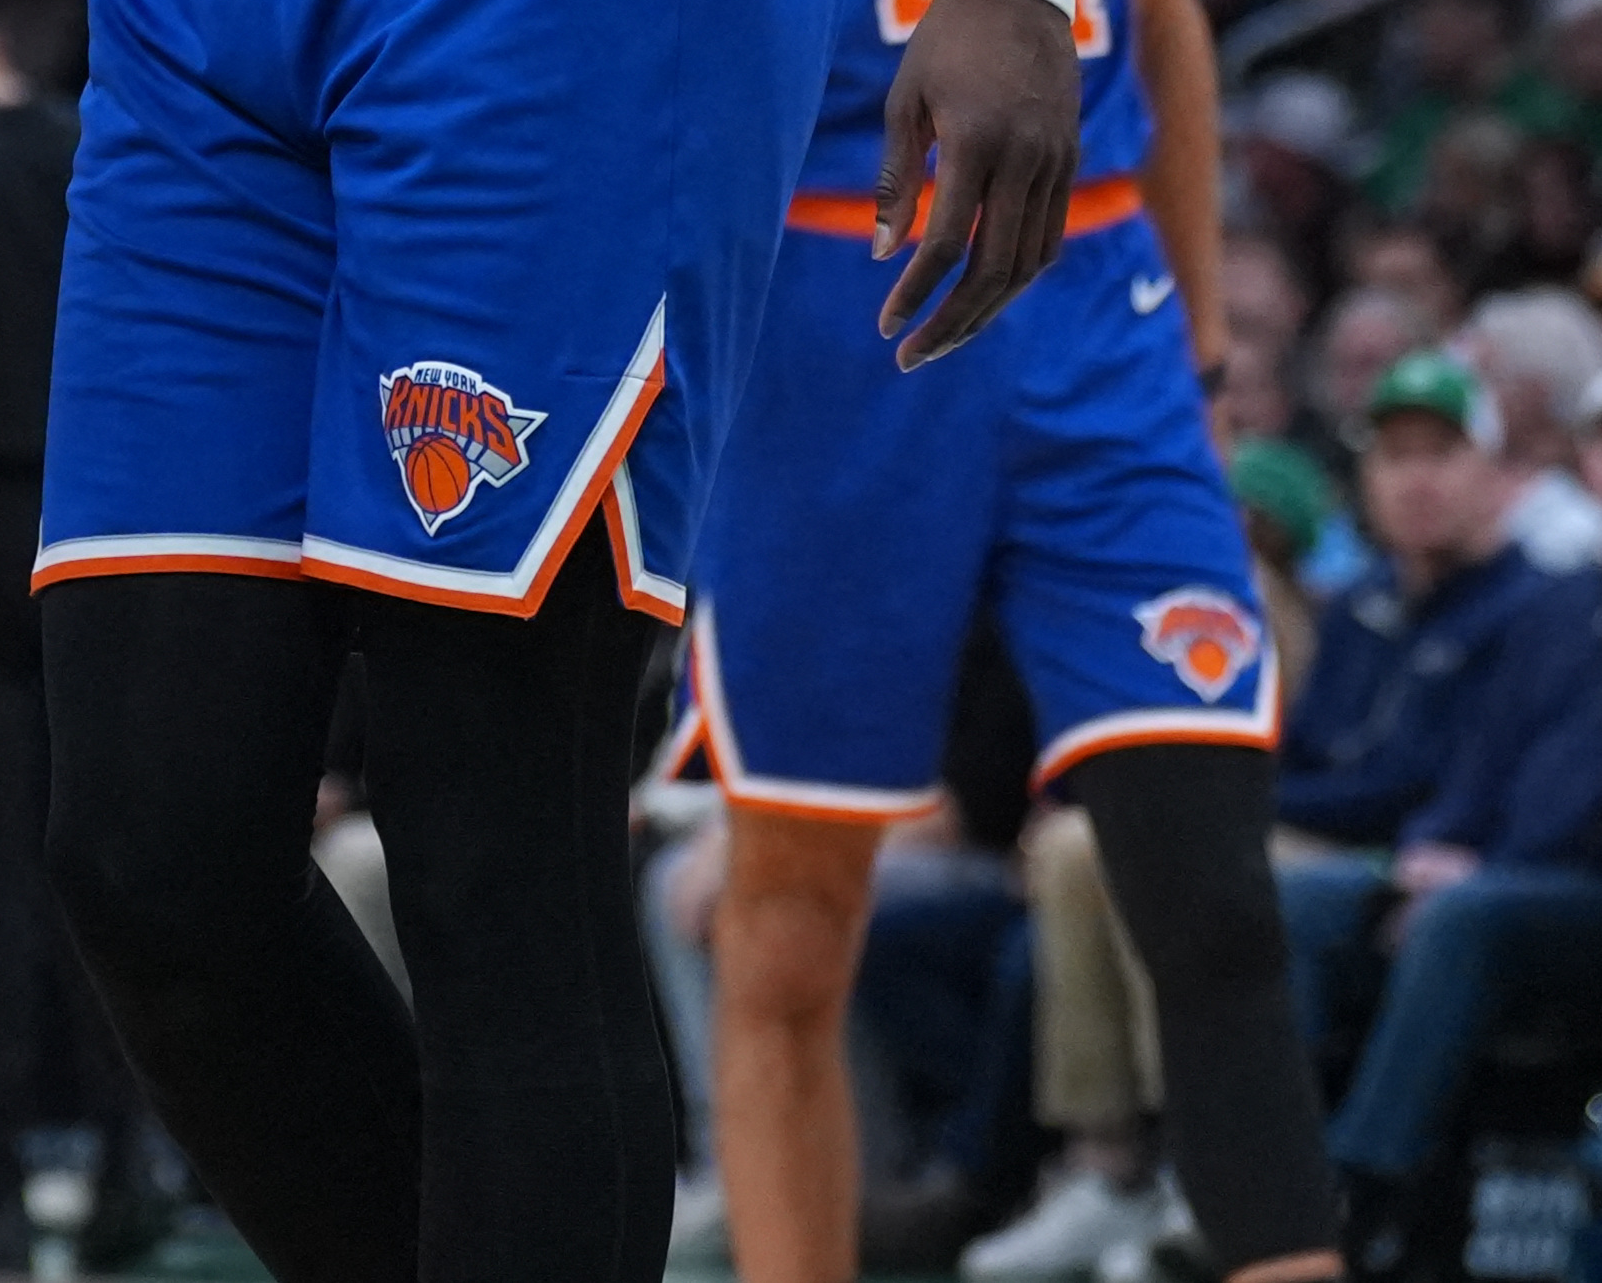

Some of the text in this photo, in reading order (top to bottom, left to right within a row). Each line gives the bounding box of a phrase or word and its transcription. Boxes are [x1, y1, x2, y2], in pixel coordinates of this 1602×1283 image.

[414, 367, 478, 394] NEW YORK
[384, 374, 522, 467] KNICKS
